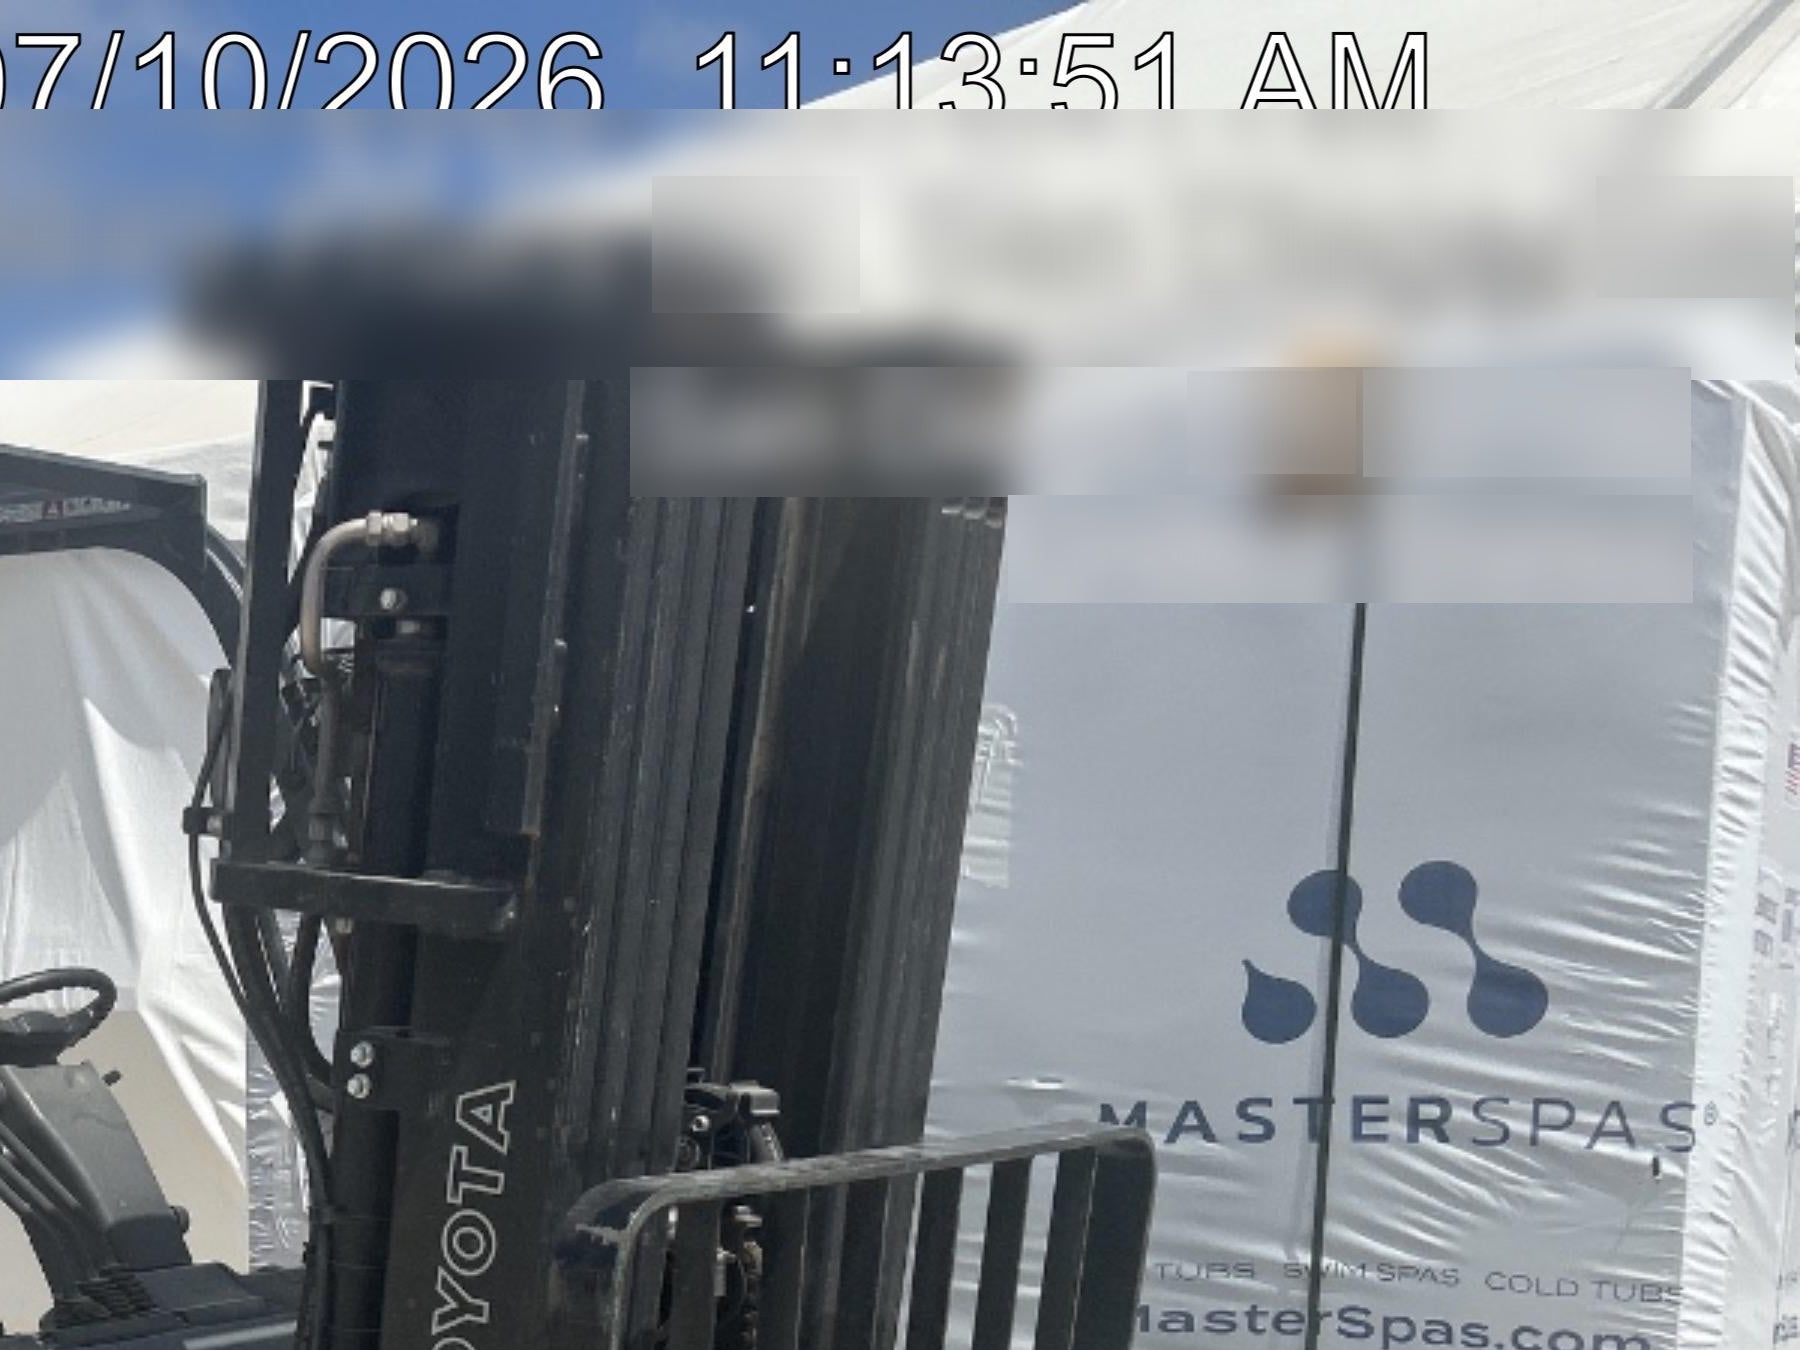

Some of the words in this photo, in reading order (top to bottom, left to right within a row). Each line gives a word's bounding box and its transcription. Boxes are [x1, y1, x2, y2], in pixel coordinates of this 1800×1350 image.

[1376, 1262, 1460, 1288] SPAS
[1484, 1270, 1579, 1298] COLD
[1591, 1280, 1684, 1304] TUBS
